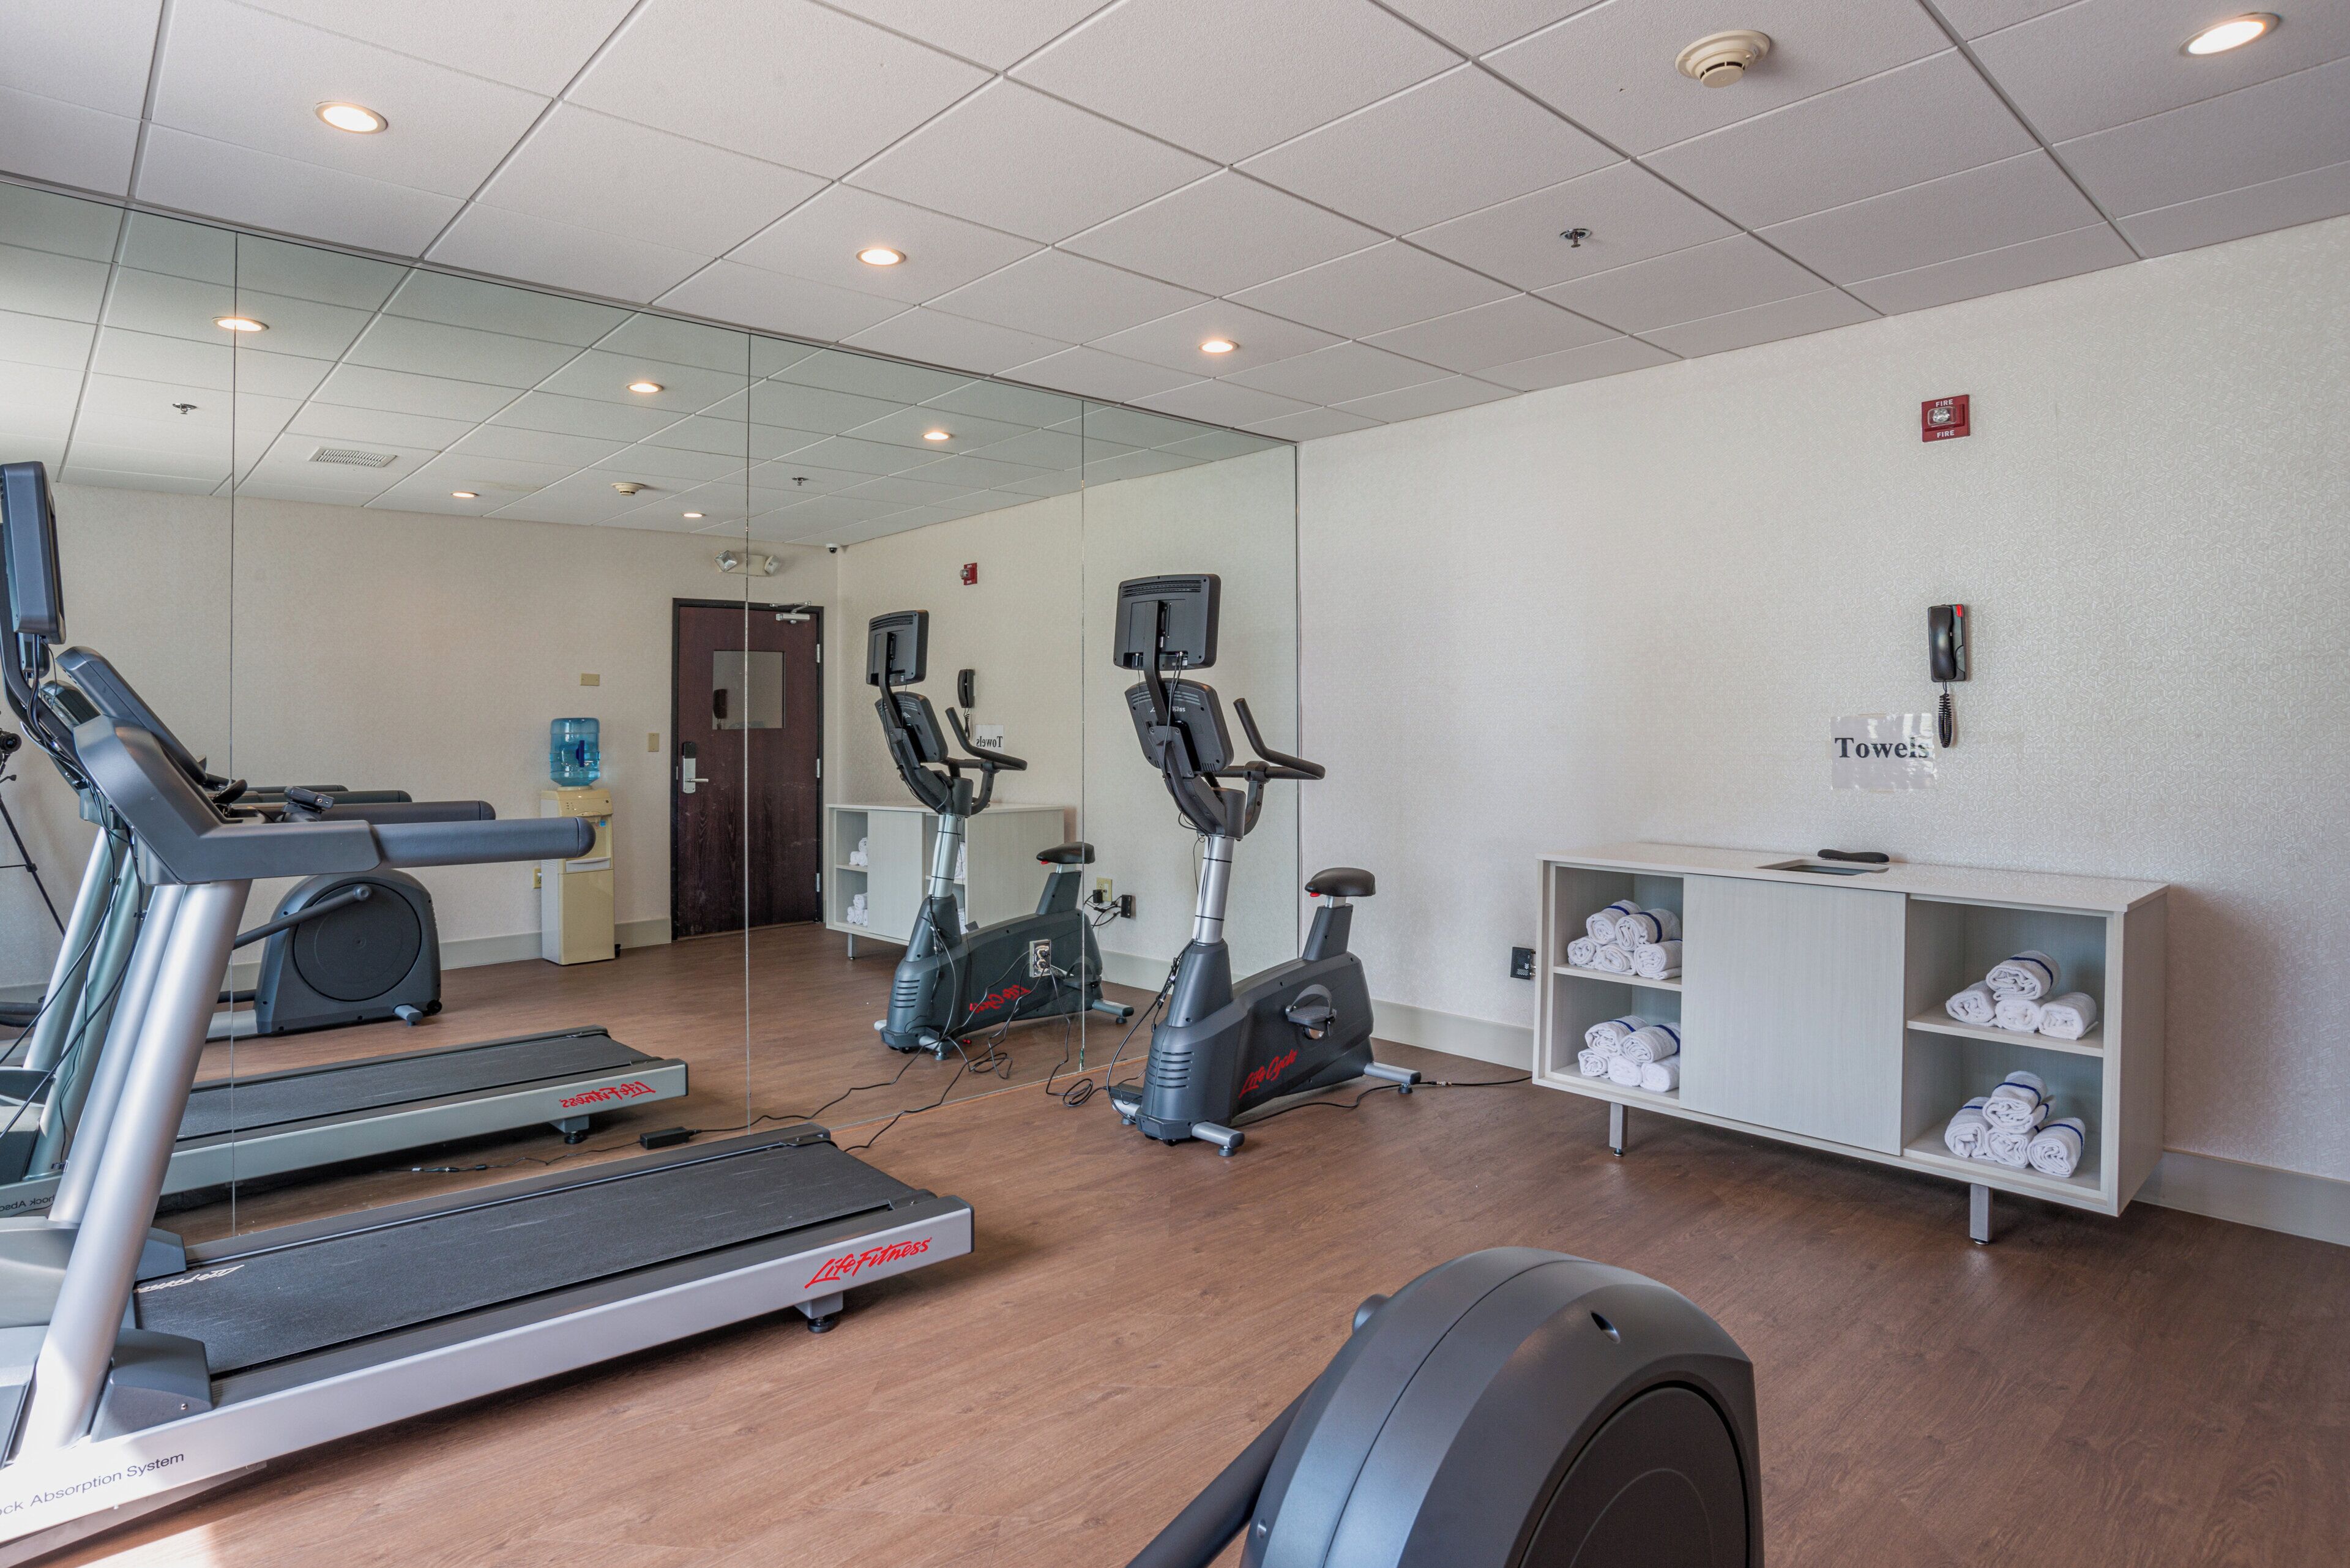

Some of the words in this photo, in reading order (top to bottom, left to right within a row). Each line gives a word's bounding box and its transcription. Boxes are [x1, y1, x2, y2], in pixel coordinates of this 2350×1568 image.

[1936, 430, 1955, 438] FIRE
[1835, 737, 1930, 758] Towels
[1238, 1066, 1266, 1100] Life
[30, 1471, 122, 1507] Absorption
[127, 1452, 185, 1477] System
